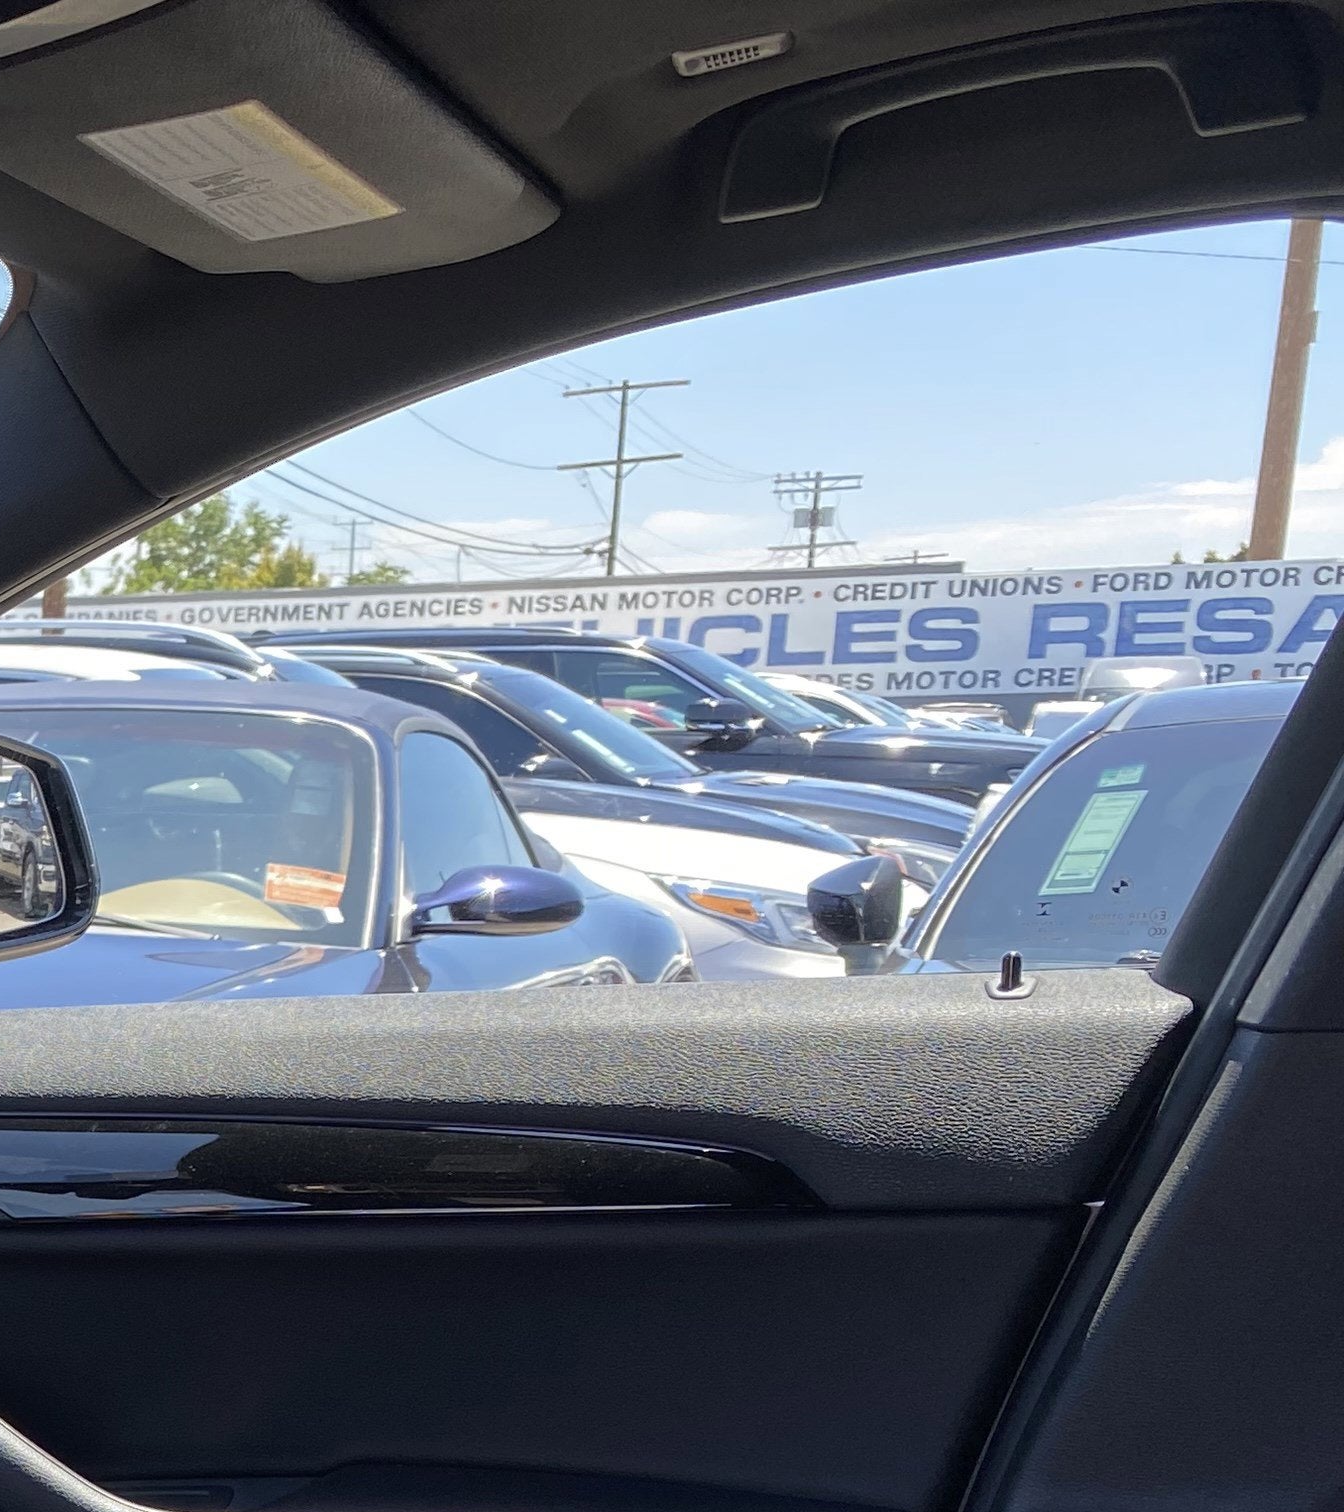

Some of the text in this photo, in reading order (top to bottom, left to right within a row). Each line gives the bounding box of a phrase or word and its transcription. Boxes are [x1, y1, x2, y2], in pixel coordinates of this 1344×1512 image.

[180, 602, 351, 626] GOVERNMENT
[359, 597, 483, 620] AGENCIES
[506, 593, 609, 615] NISSAN
[617, 589, 714, 611] MOTOR
[725, 585, 805, 607] CORP.
[832, 579, 938, 602] CREDIT
[947, 575, 1064, 598] UNIONS
[1091, 571, 1174, 593] FORD
[1184, 565, 1302, 591] MOTOR
[885, 669, 1002, 691] MOTOR
[1013, 666, 1083, 689] CRE
